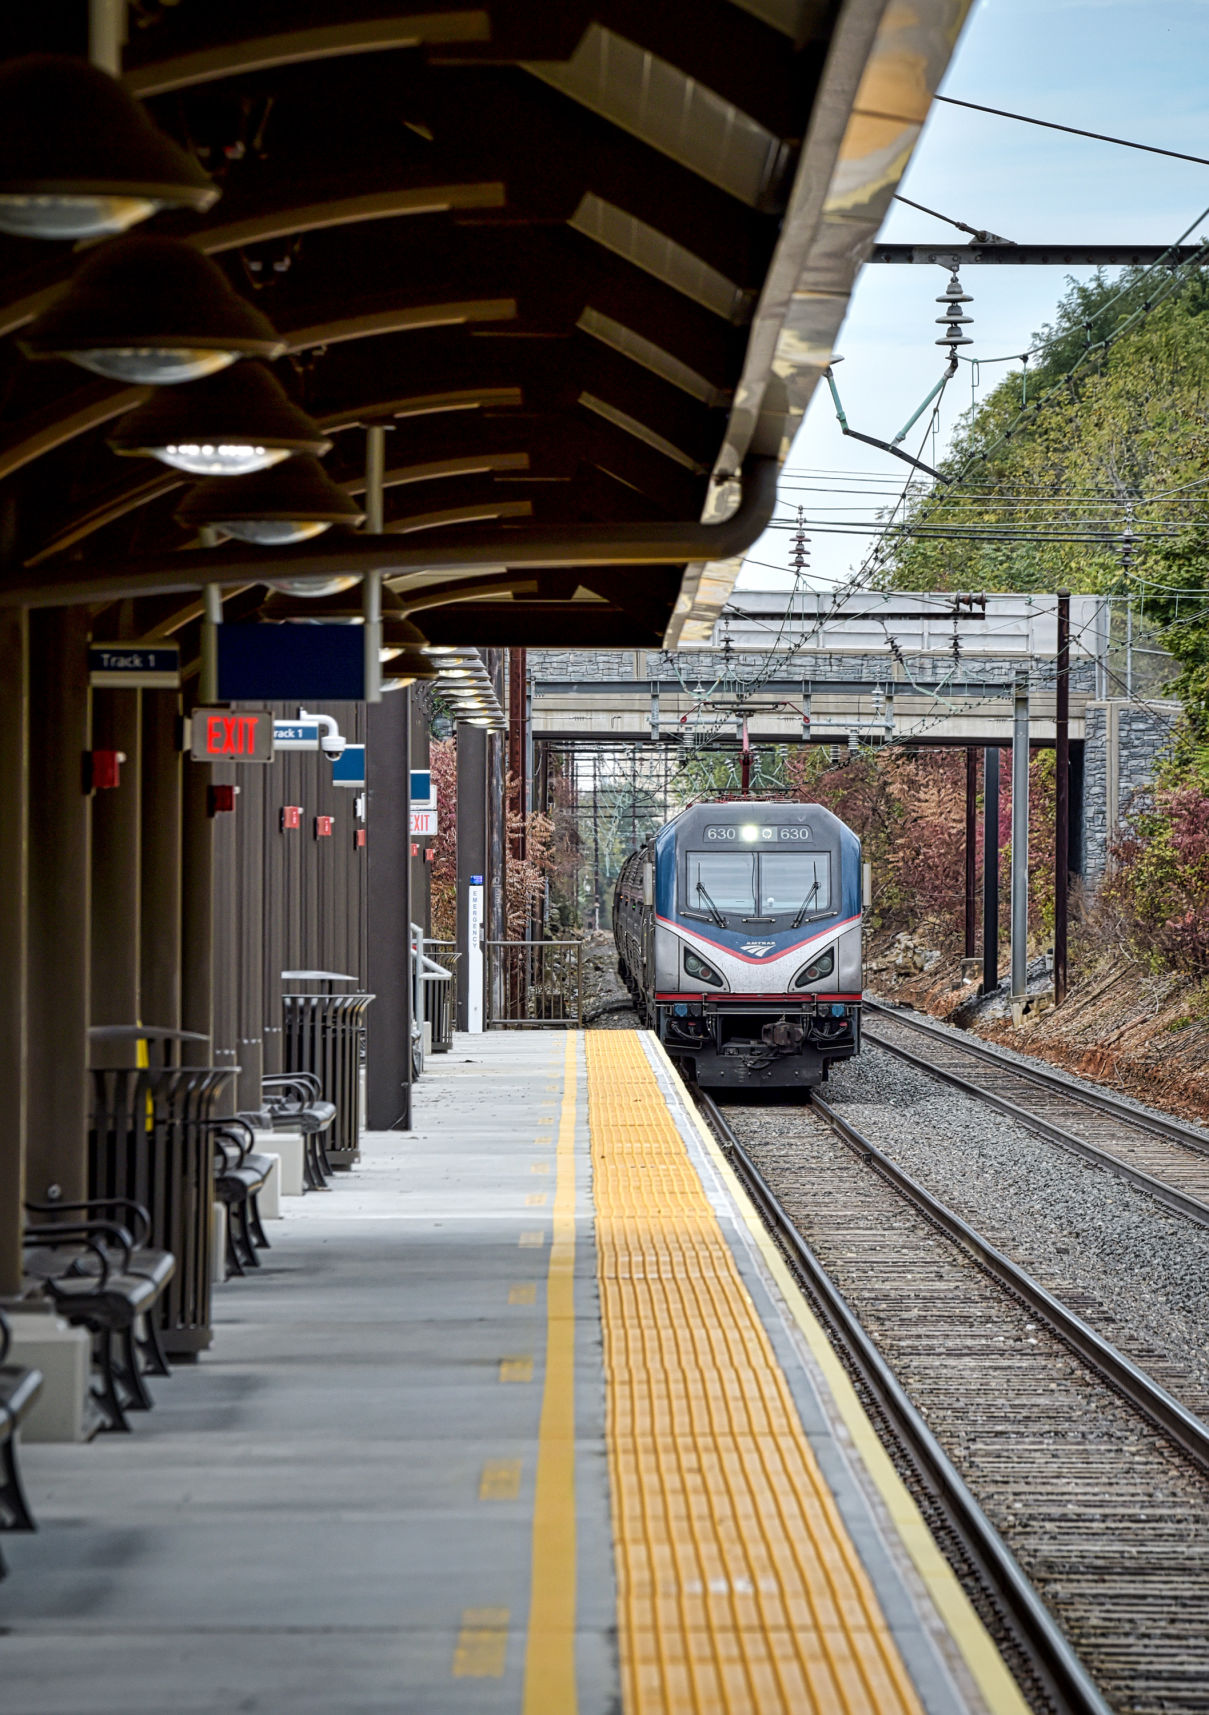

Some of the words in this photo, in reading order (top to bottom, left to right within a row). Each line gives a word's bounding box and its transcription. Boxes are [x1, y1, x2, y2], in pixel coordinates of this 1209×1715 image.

[101, 654, 142, 667] Track
[148, 654, 156, 667] 1
[207, 716, 258, 754] EXIT
[274, 728, 295, 738] rack
[297, 729, 303, 738] 1
[707, 828, 736, 840] 630
[780, 828, 809, 840] 630
